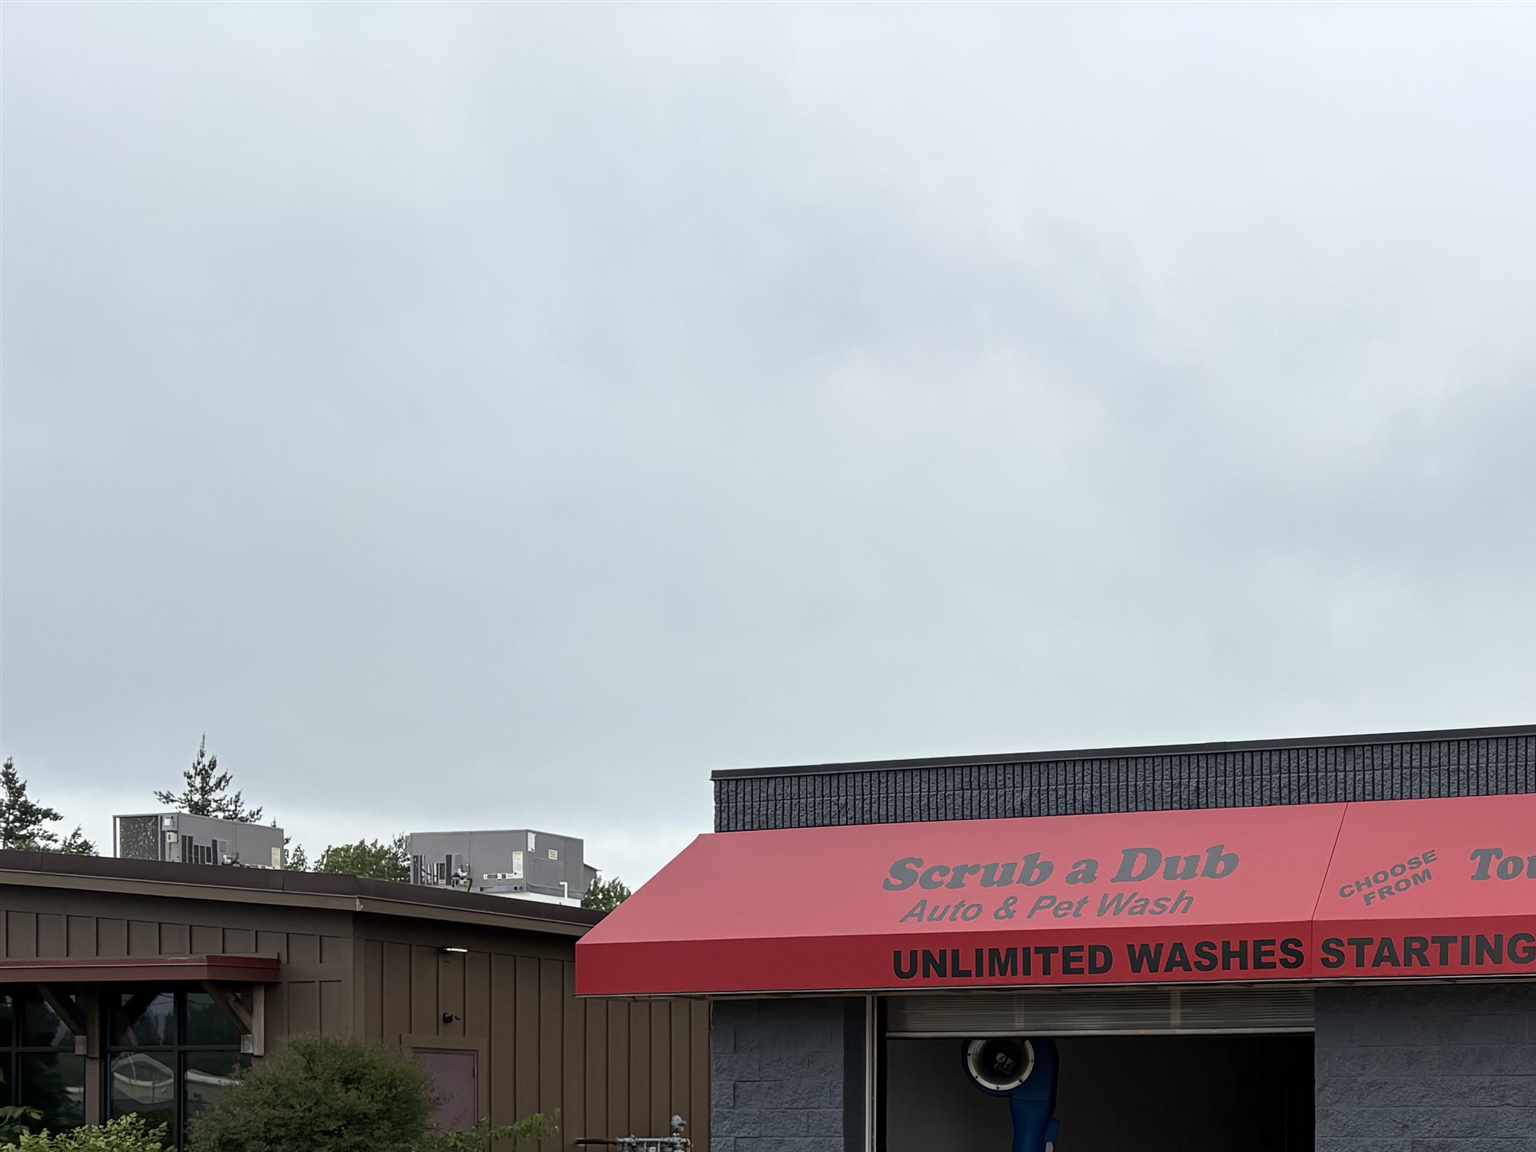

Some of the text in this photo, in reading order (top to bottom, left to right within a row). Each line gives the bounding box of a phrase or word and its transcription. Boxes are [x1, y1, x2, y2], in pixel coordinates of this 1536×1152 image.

[883, 844, 1240, 892] Scrub a Dub
[1338, 849, 1438, 899] CHOOSE
[1362, 868, 1433, 907] FROM
[899, 890, 1195, 924] Auto & Pet Wash
[892, 943, 1114, 980] UNLIMITED
[1127, 937, 1305, 975] WASHES
[1320, 932, 1536, 969] STARTING
